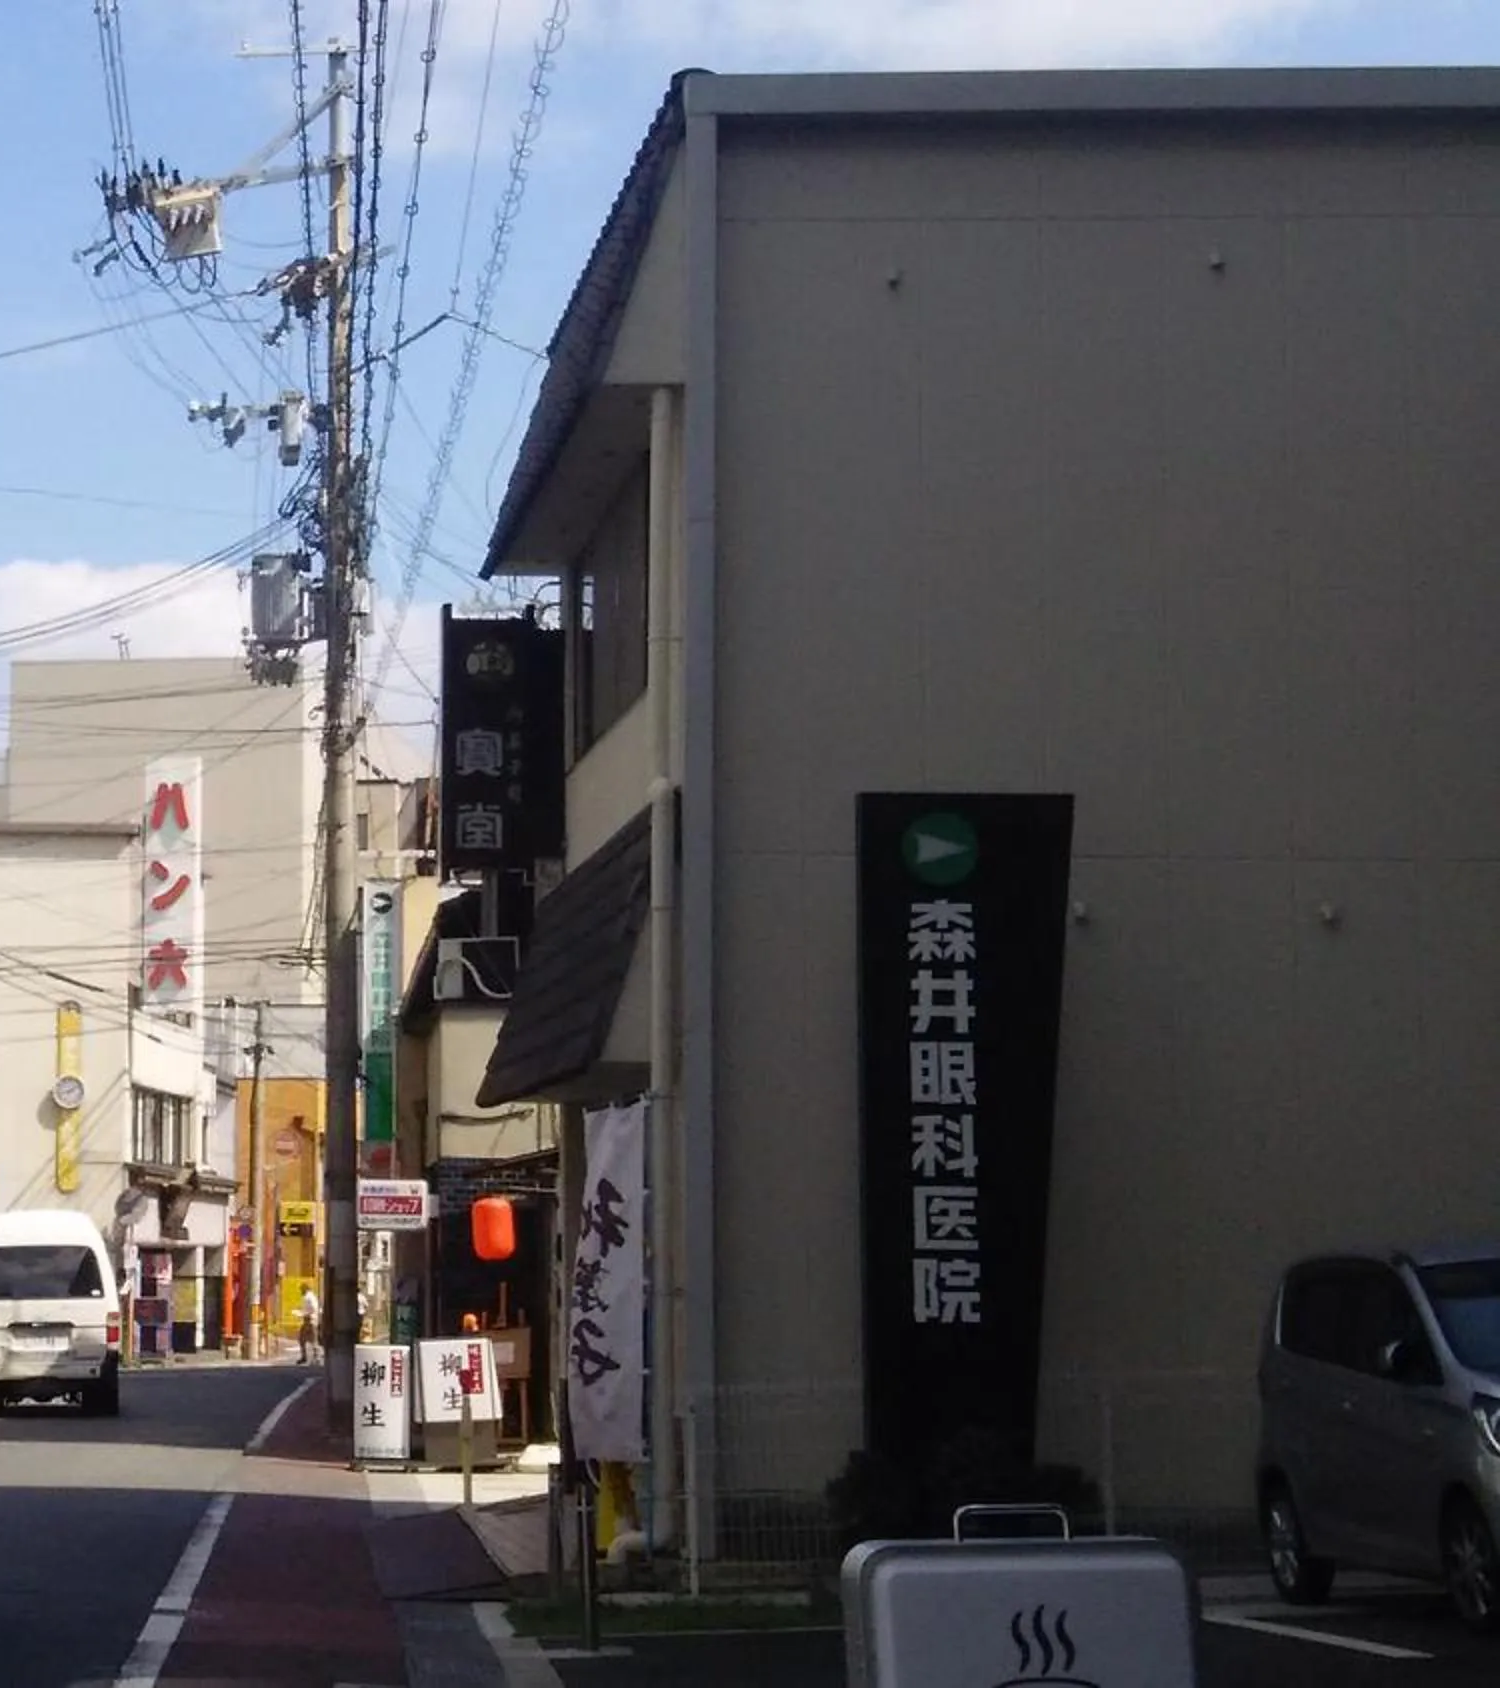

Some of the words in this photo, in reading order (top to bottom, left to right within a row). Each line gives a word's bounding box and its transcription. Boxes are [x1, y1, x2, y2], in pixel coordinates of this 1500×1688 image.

[907, 899, 981, 1324] 森井眼科医院
[361, 1361, 386, 1427] 柳生
[438, 1352, 462, 1411] 柳生
